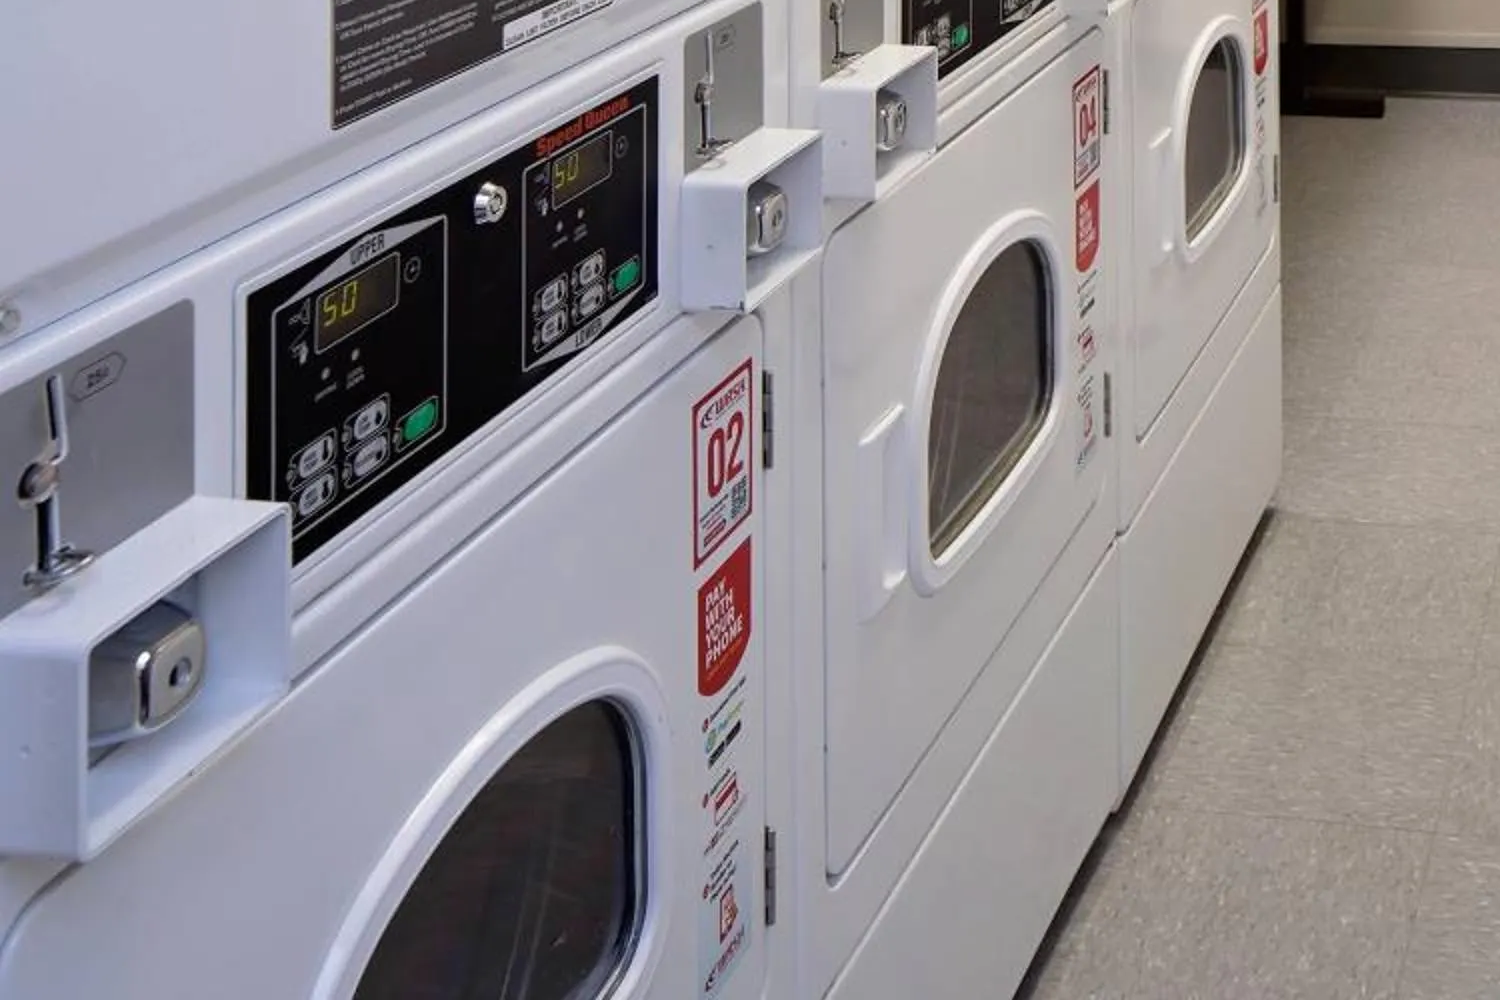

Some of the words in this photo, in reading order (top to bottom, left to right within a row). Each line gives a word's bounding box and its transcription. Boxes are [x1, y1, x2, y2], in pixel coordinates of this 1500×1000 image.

[535, 117, 583, 159] Speed
[554, 149, 580, 190] 50
[350, 233, 386, 266] UPPER
[322, 279, 359, 328] 50
[575, 317, 603, 349] LOWER
[707, 410, 745, 499] 02
[704, 575, 727, 613] PAY
[704, 587, 734, 632] WITH
[704, 605, 736, 649] YOUR
[704, 613, 745, 671] PHONE
